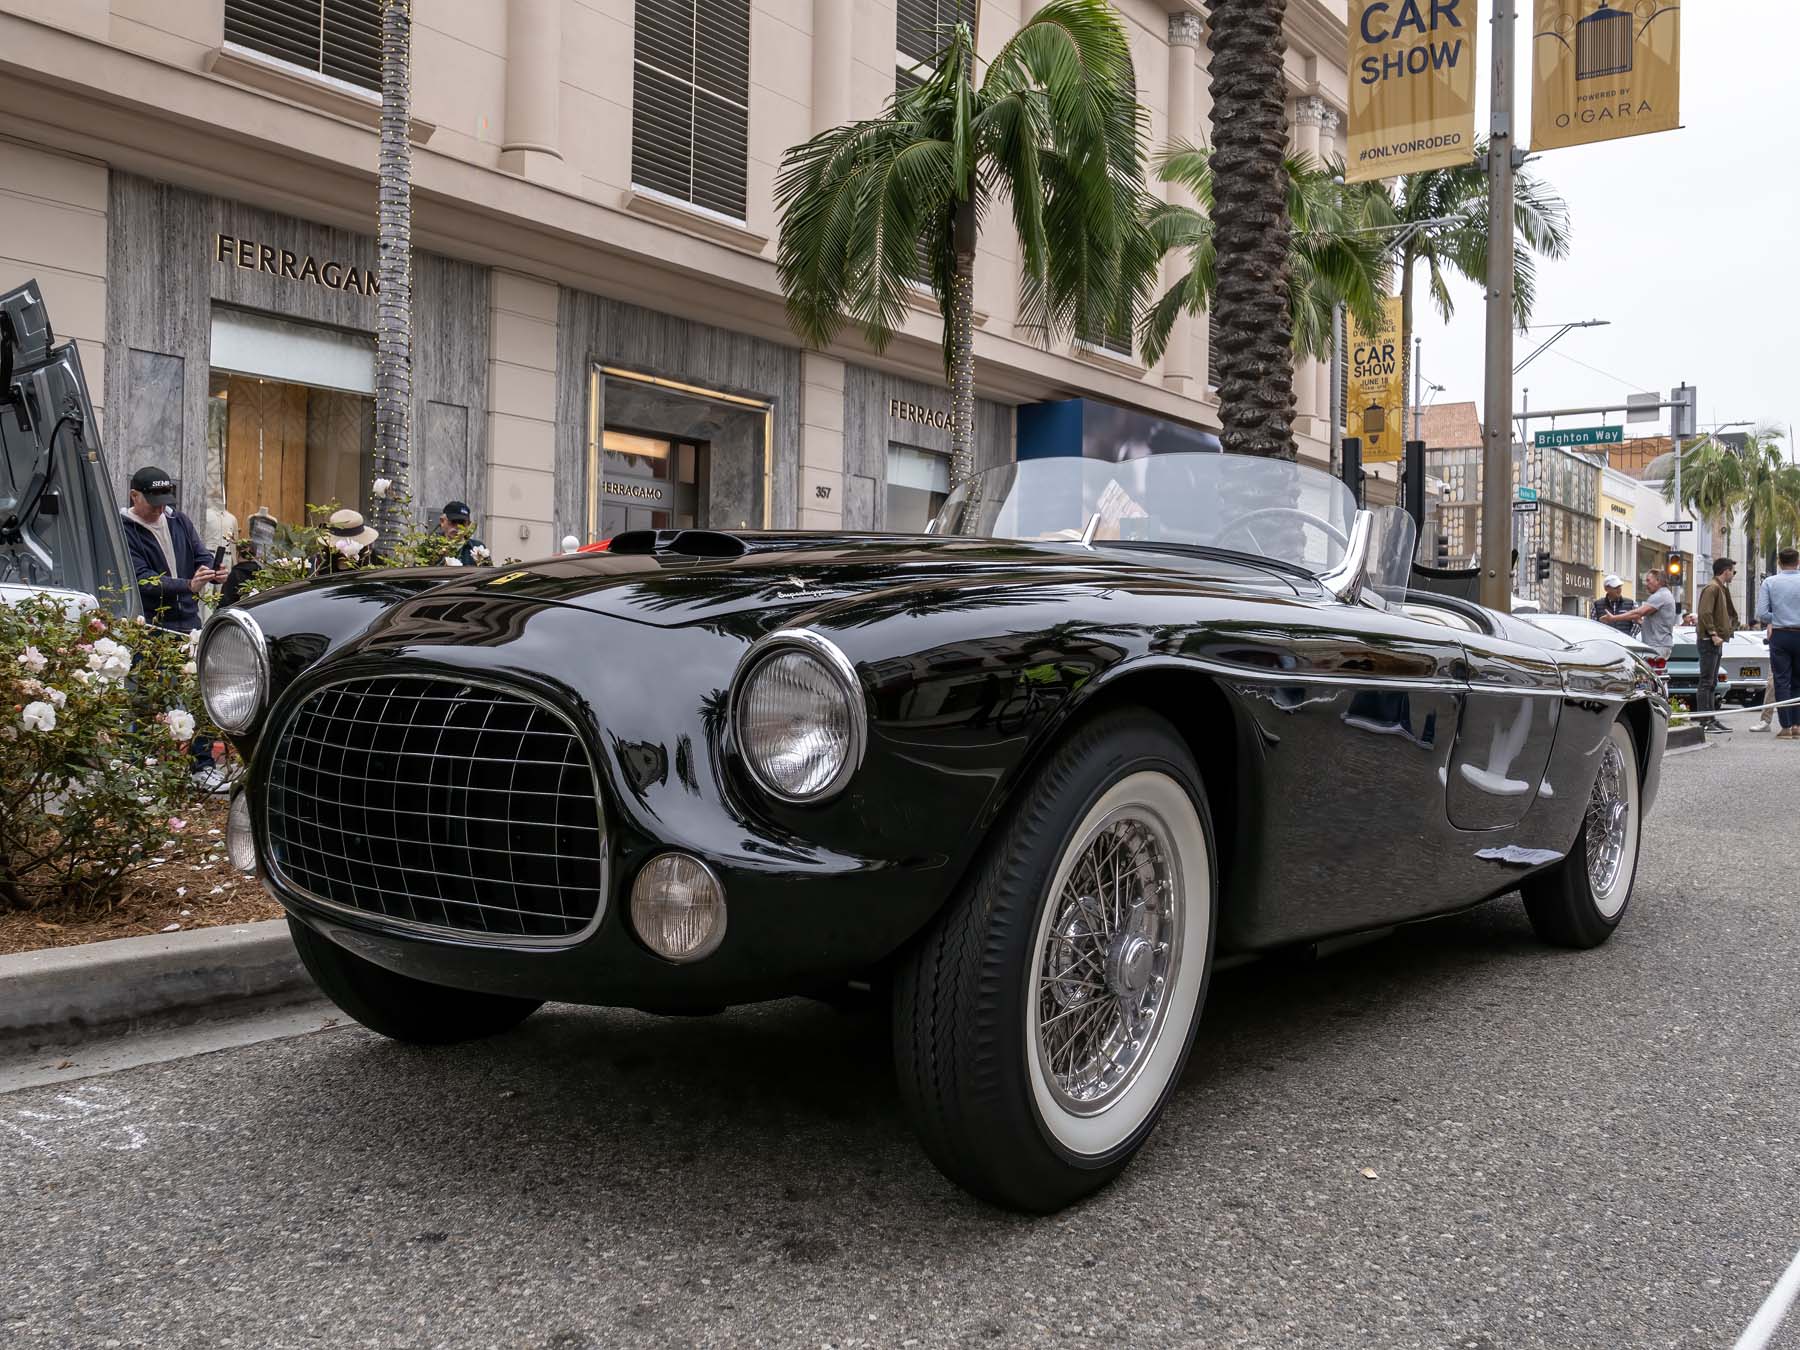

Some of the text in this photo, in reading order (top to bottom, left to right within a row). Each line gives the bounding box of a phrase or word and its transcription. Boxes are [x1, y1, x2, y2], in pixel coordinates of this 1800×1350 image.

[1360, 0, 1462, 44] CAR
[1361, 40, 1462, 85] SHOW
[1577, 88, 1630, 102] POWERED BY
[1555, 100, 1652, 128] O'GARA
[1359, 133, 1461, 161] #ONLYONRODEO
[216, 233, 411, 299] FERRAGAM
[1354, 344, 1395, 365] CAR
[1354, 362, 1395, 378] SHOW
[1361, 378, 1379, 386] JUNE
[889, 399, 974, 432] FERRAGA
[1538, 430, 1618, 446] Brighton Way
[816, 486, 832, 499] 357
[1565, 573, 1593, 590] BVLGARI
